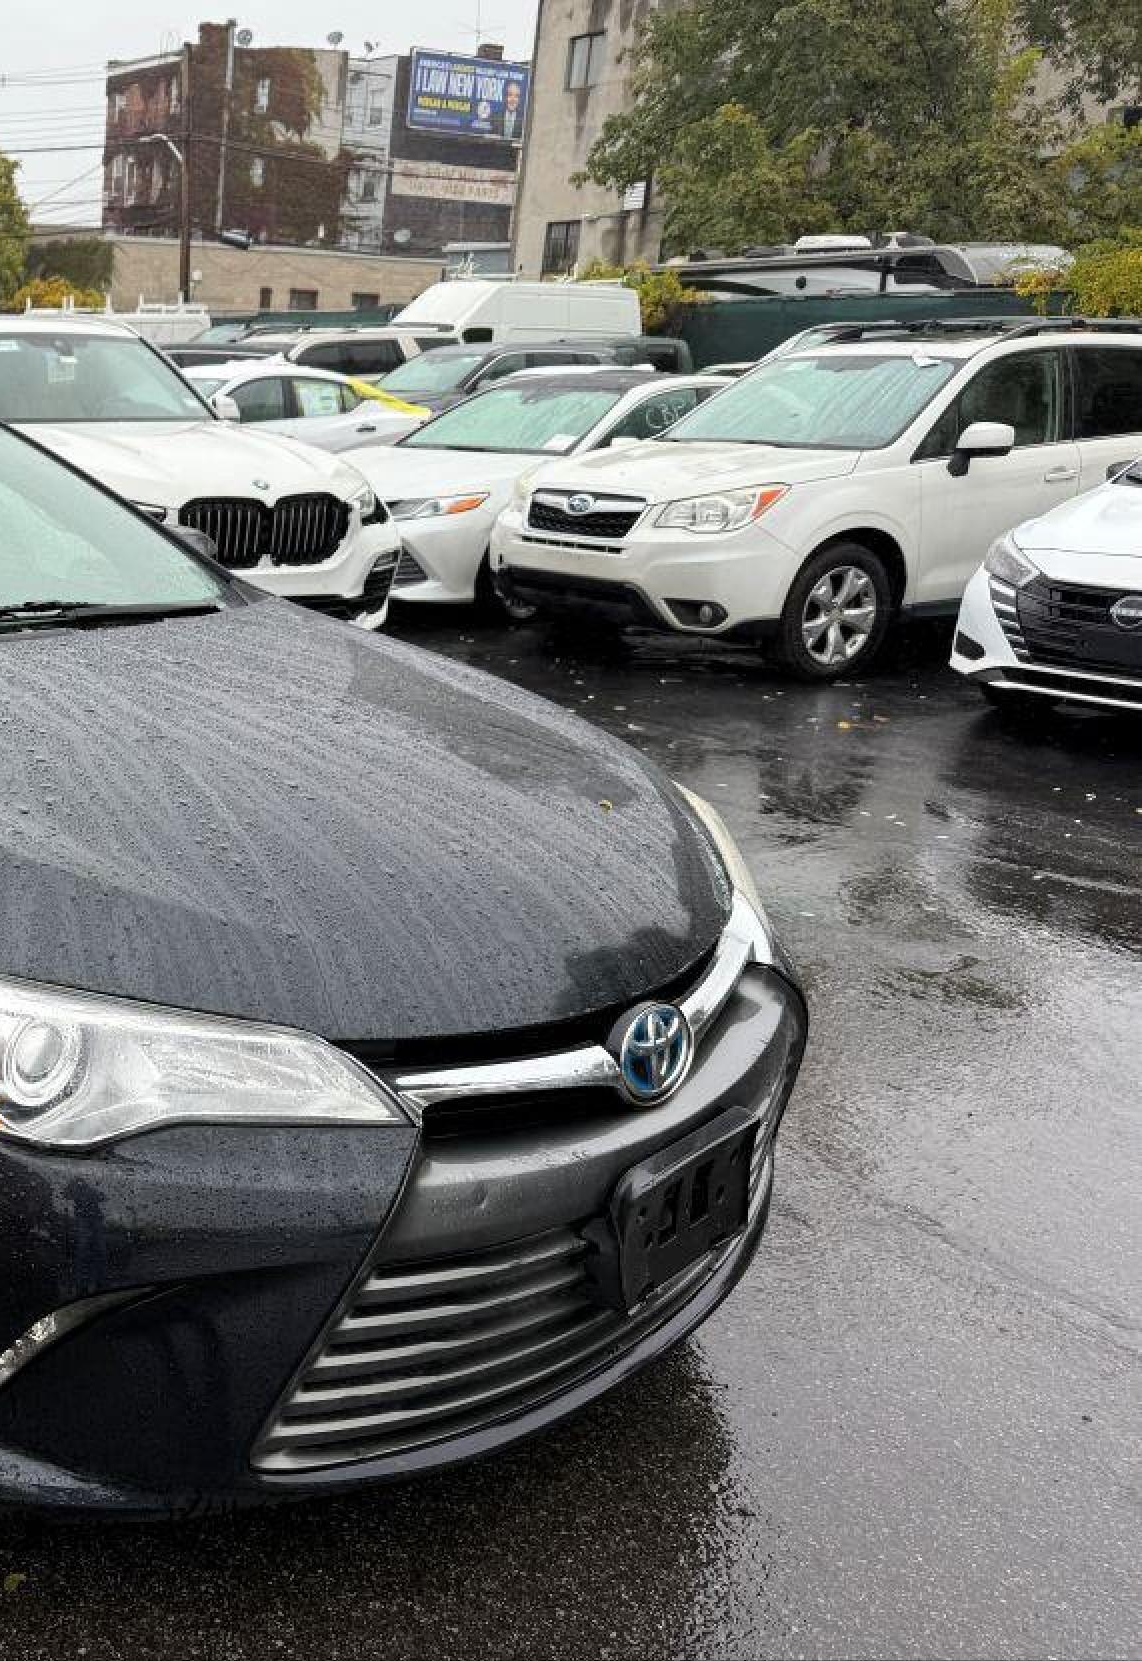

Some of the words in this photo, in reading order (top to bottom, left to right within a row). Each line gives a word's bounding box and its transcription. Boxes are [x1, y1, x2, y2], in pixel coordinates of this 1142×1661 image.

[422, 68, 448, 95] LAW
[448, 73, 475, 98] NEW
[476, 77, 505, 102] YORK
